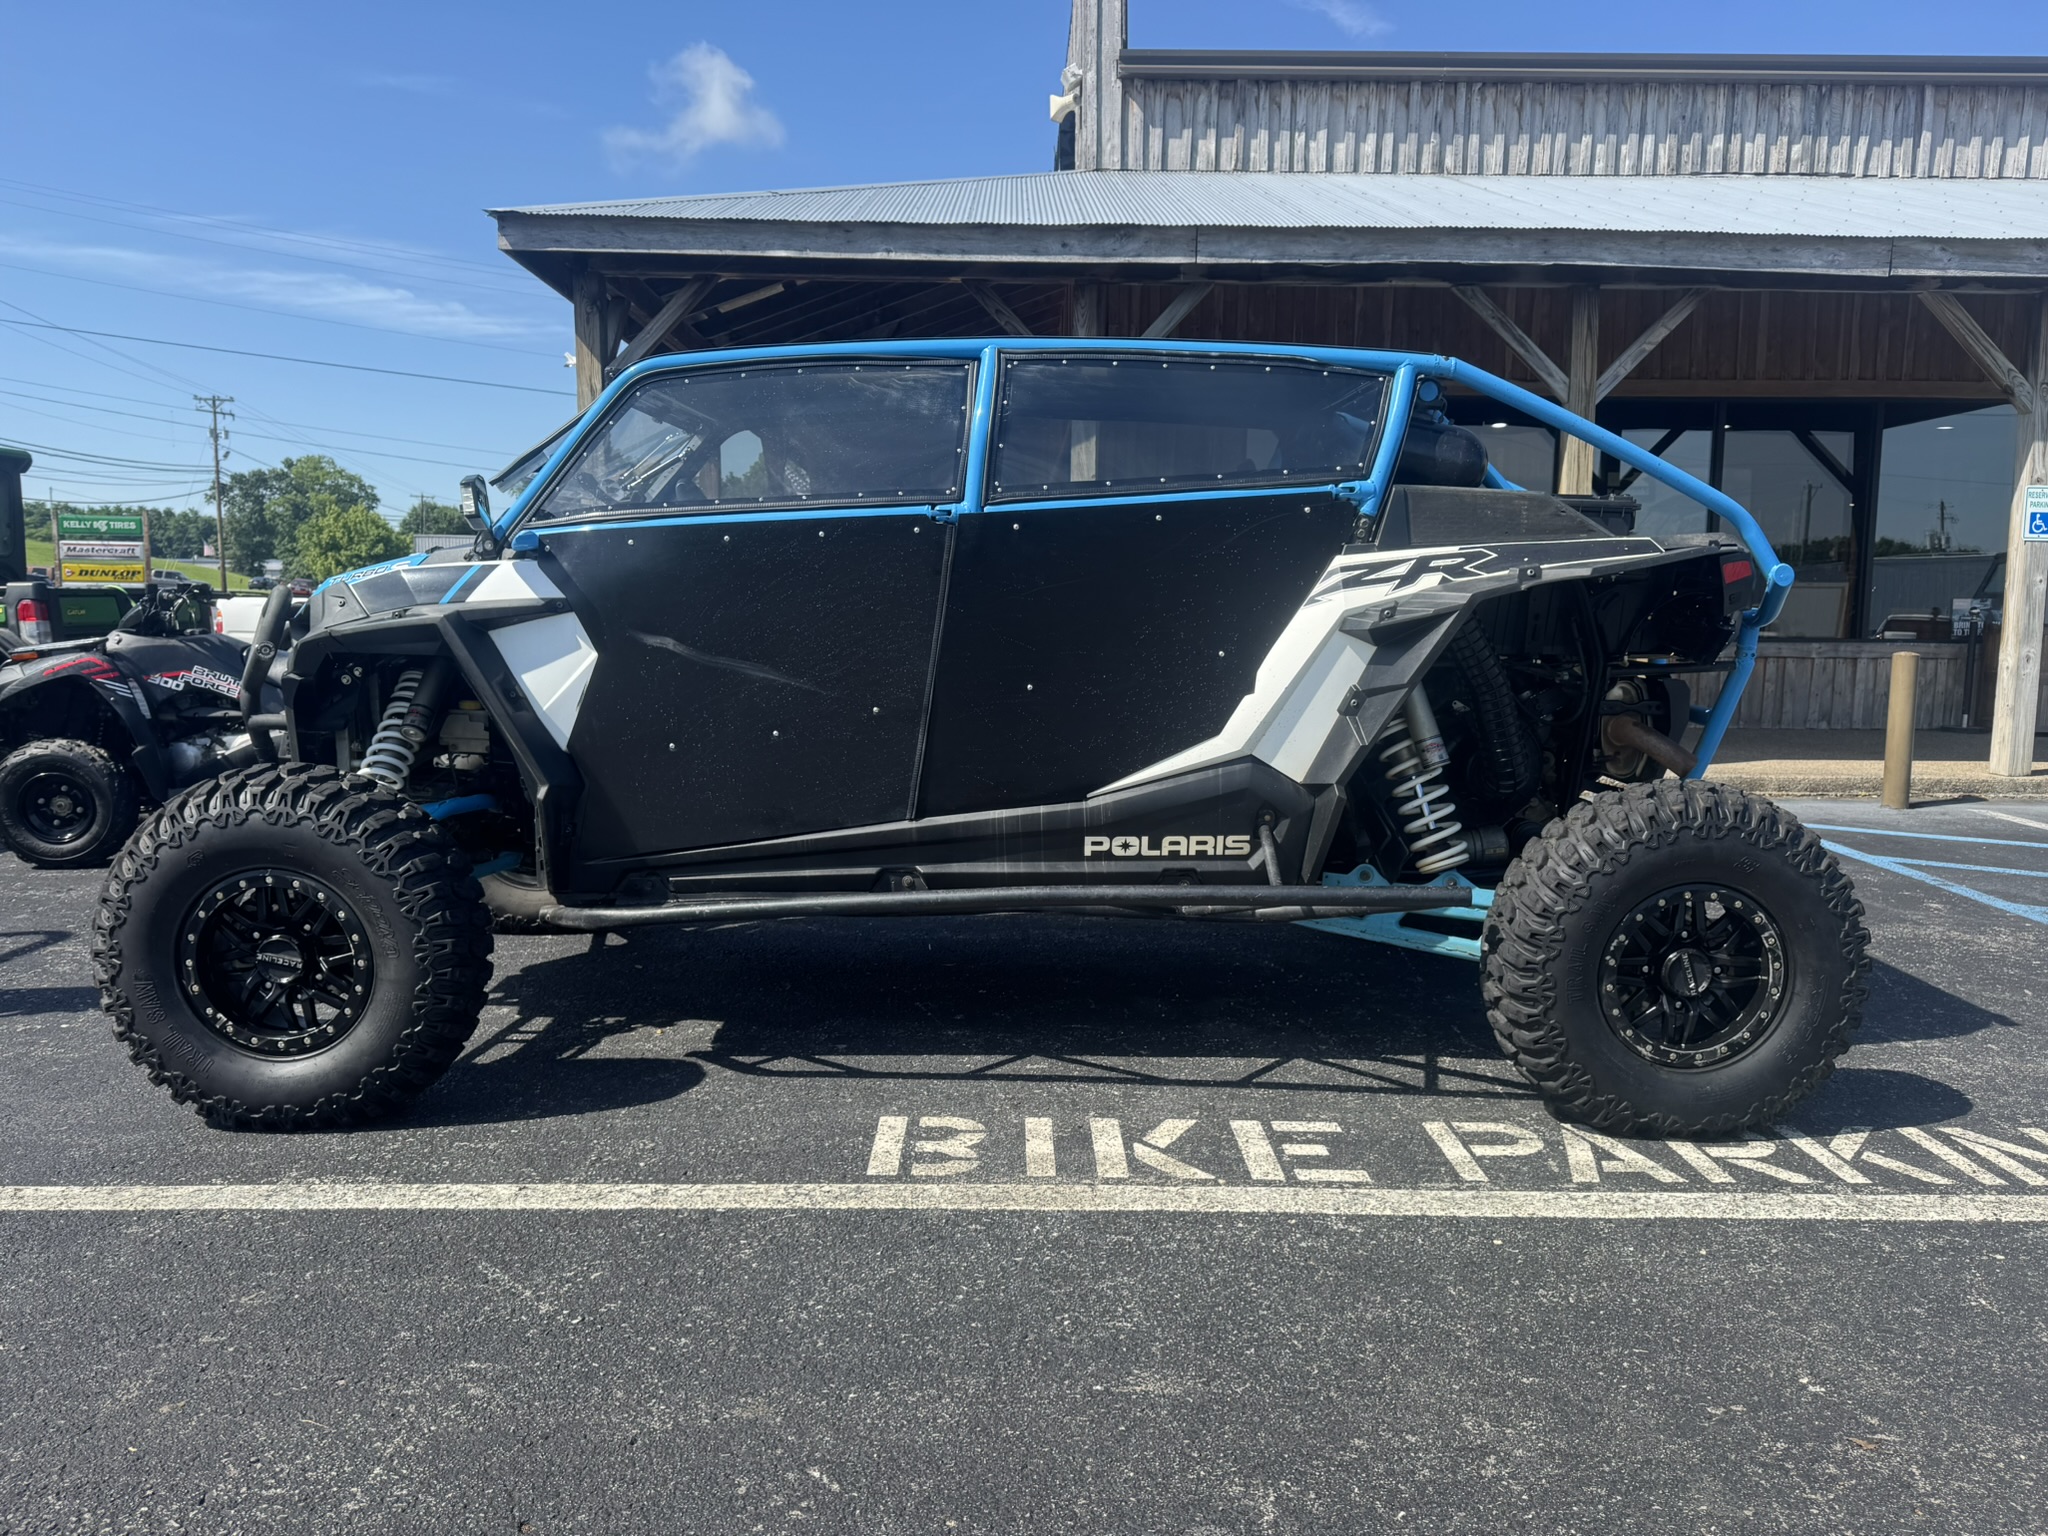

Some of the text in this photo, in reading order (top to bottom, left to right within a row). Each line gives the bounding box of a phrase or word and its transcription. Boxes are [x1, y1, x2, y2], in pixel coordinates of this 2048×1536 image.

[63, 520, 91, 529] KELLY
[109, 521, 137, 530] TIRES
[66, 546, 136, 555] Mastercraft
[77, 568, 142, 578] DUNLOP
[1303, 548, 1499, 608] ZR
[178, 671, 241, 699] FORCE
[192, 664, 242, 688] BRUT
[1084, 834, 1251, 857] POLARIS
[255, 952, 304, 969] RACELINE
[133, 980, 167, 1025] SAW
[162, 1022, 216, 1080] TRAIL
[866, 1116, 1374, 1184] BIKE
